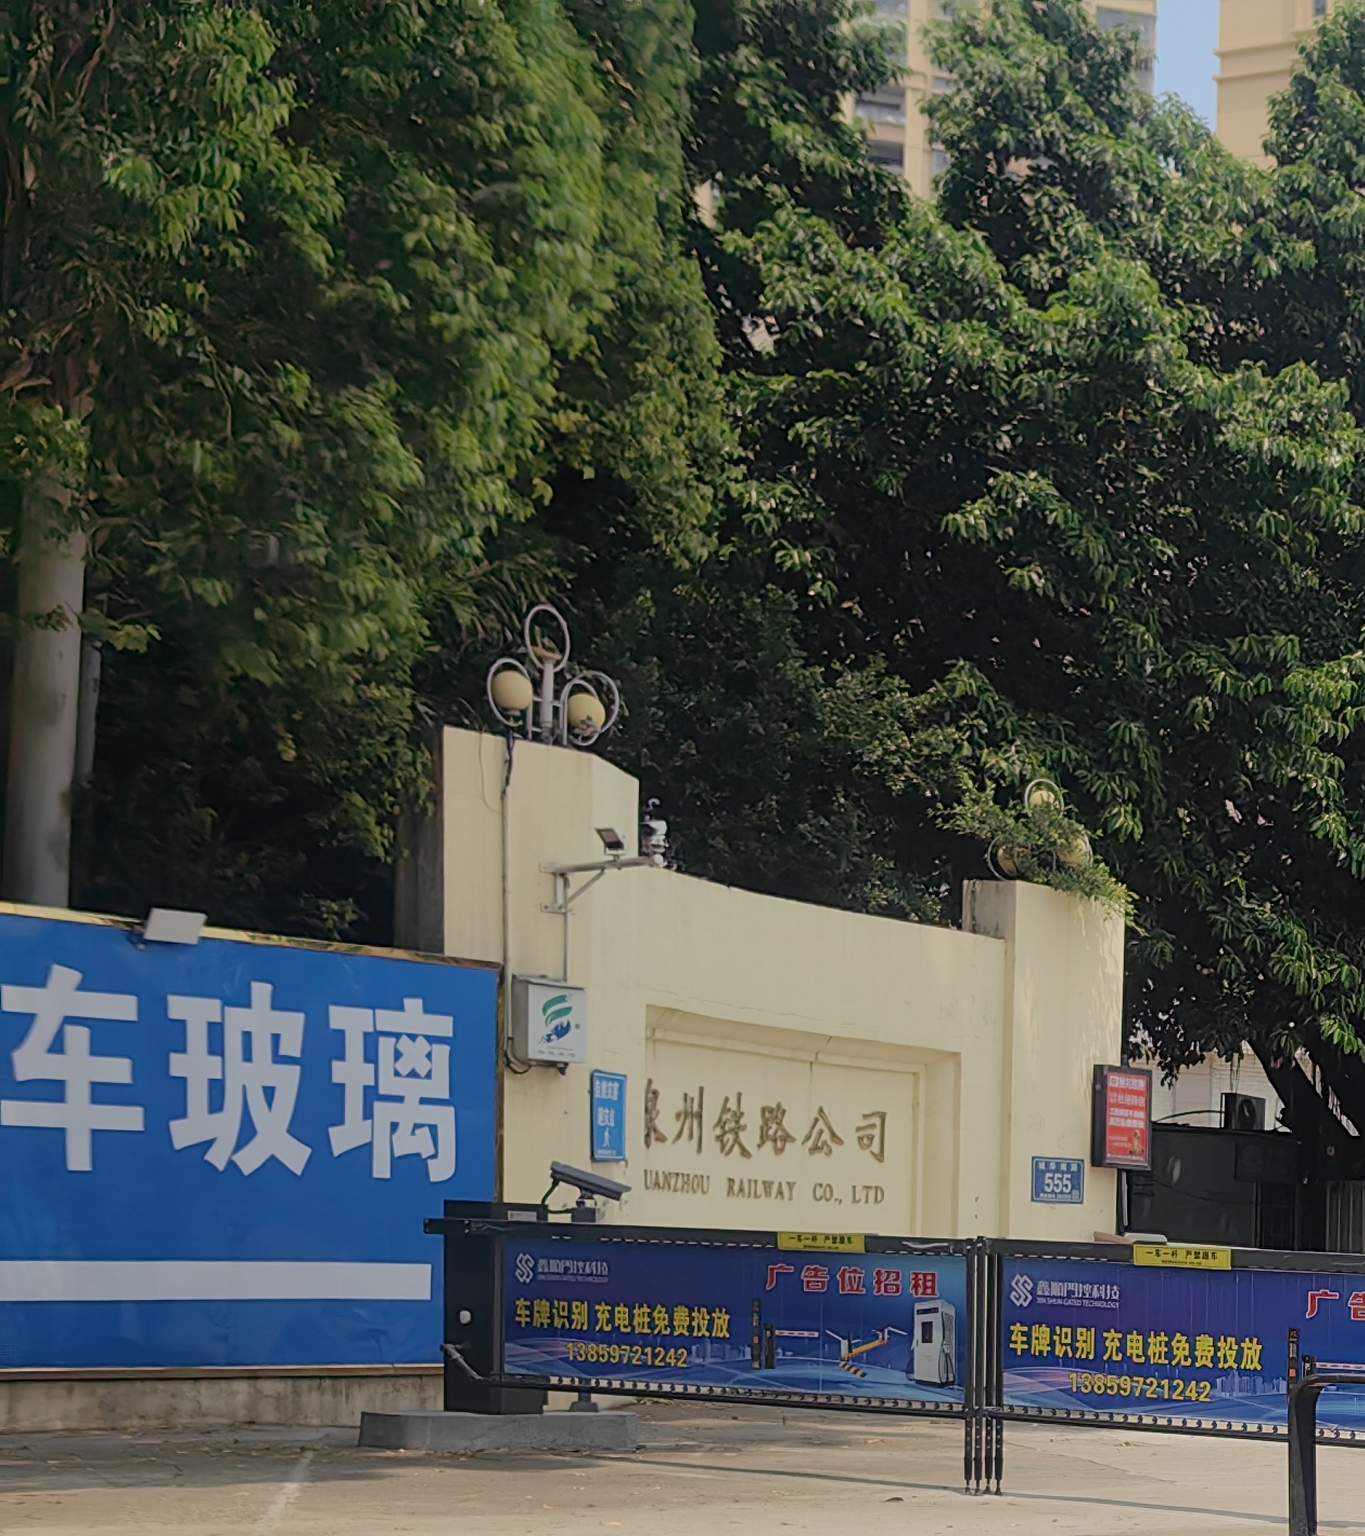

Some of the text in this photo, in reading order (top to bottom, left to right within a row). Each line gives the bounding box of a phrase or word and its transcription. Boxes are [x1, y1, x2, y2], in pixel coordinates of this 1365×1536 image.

[0, 963, 456, 1183] 车玻璃
[726, 1177, 796, 1201] RAILWAY
[851, 1184, 885, 1205] LTD
[1044, 1173, 1072, 1193] 555
[766, 1263, 939, 1298] 广告位招租
[514, 1297, 730, 1338] 车牌识别 充电桩免费投放
[566, 1342, 688, 1367] 13859721242
[1009, 1323, 1263, 1371] 车牌识别 充电桩免费投放
[1068, 1372, 1212, 1402] 13859721242
